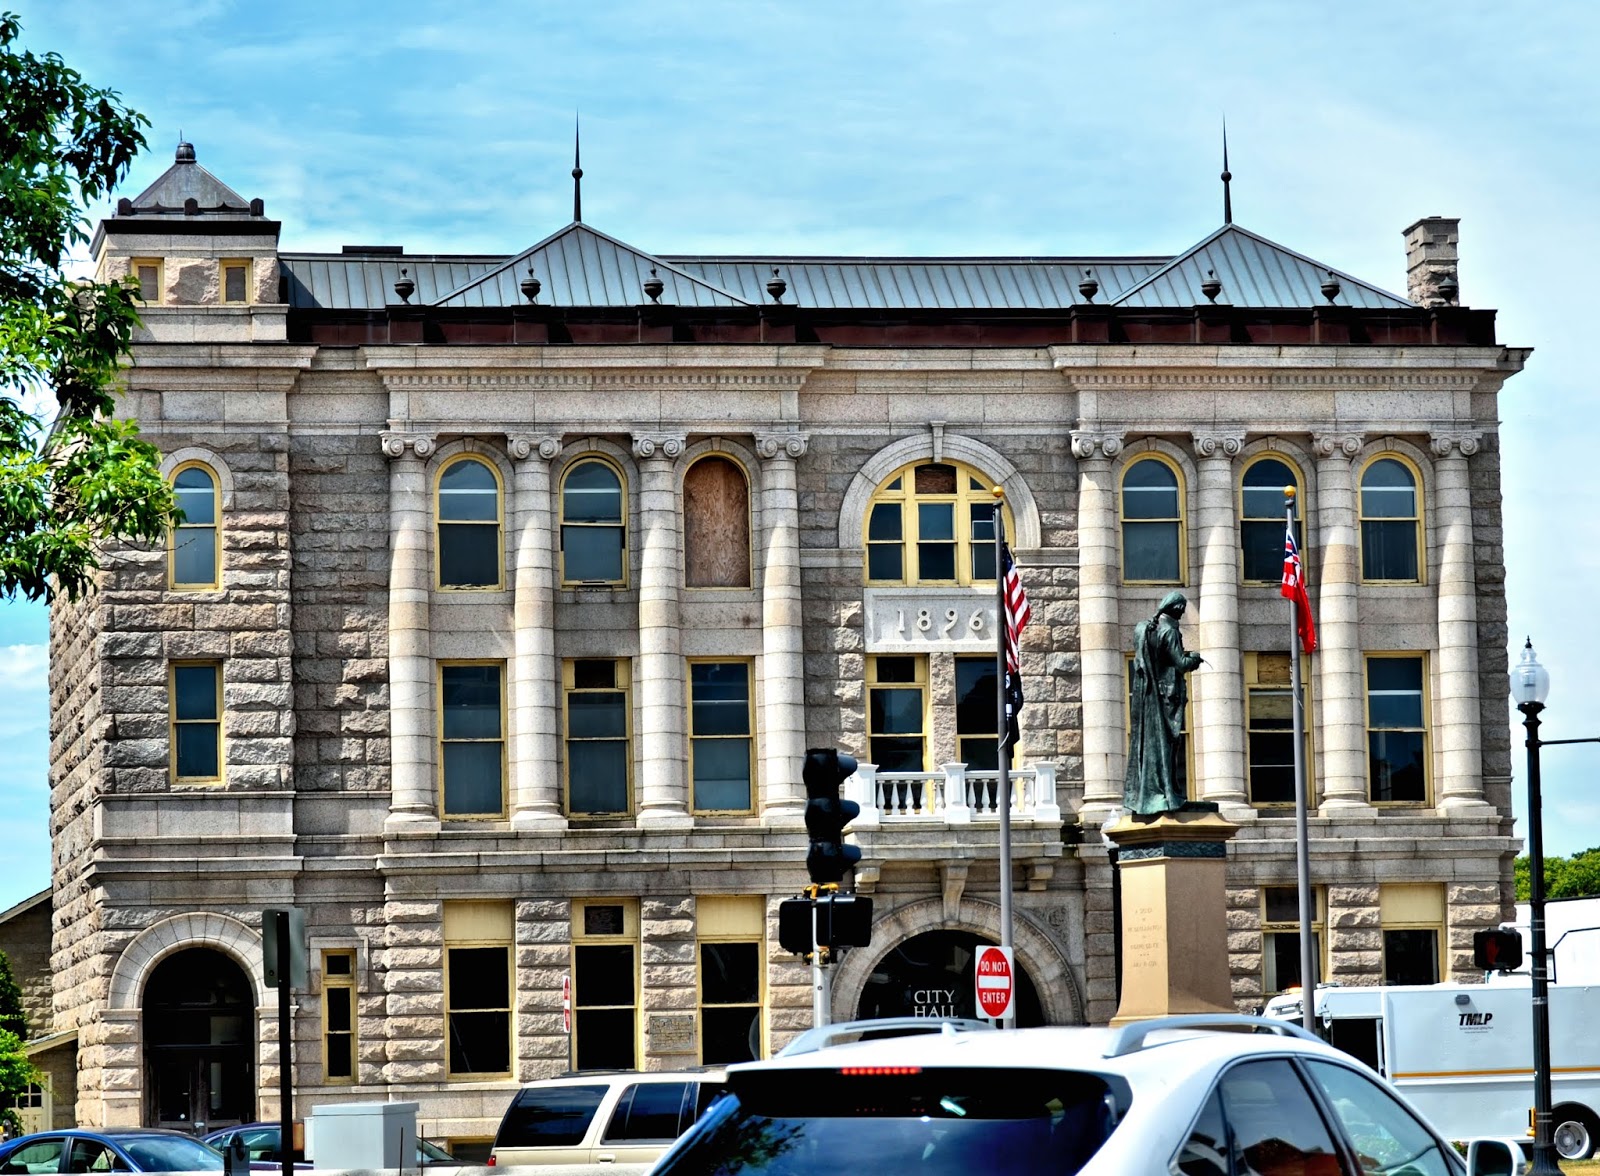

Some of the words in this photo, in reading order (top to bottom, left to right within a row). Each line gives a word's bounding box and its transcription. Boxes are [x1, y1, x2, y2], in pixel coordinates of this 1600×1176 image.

[898, 607, 984, 632] 1896
[980, 961, 990, 972] DO
[992, 962, 1006, 972] NOT
[914, 990, 955, 1004] CITY
[982, 992, 1006, 1003] ENTER
[914, 1005, 958, 1018] HALL
[1459, 1013, 1493, 1026] TMLP
